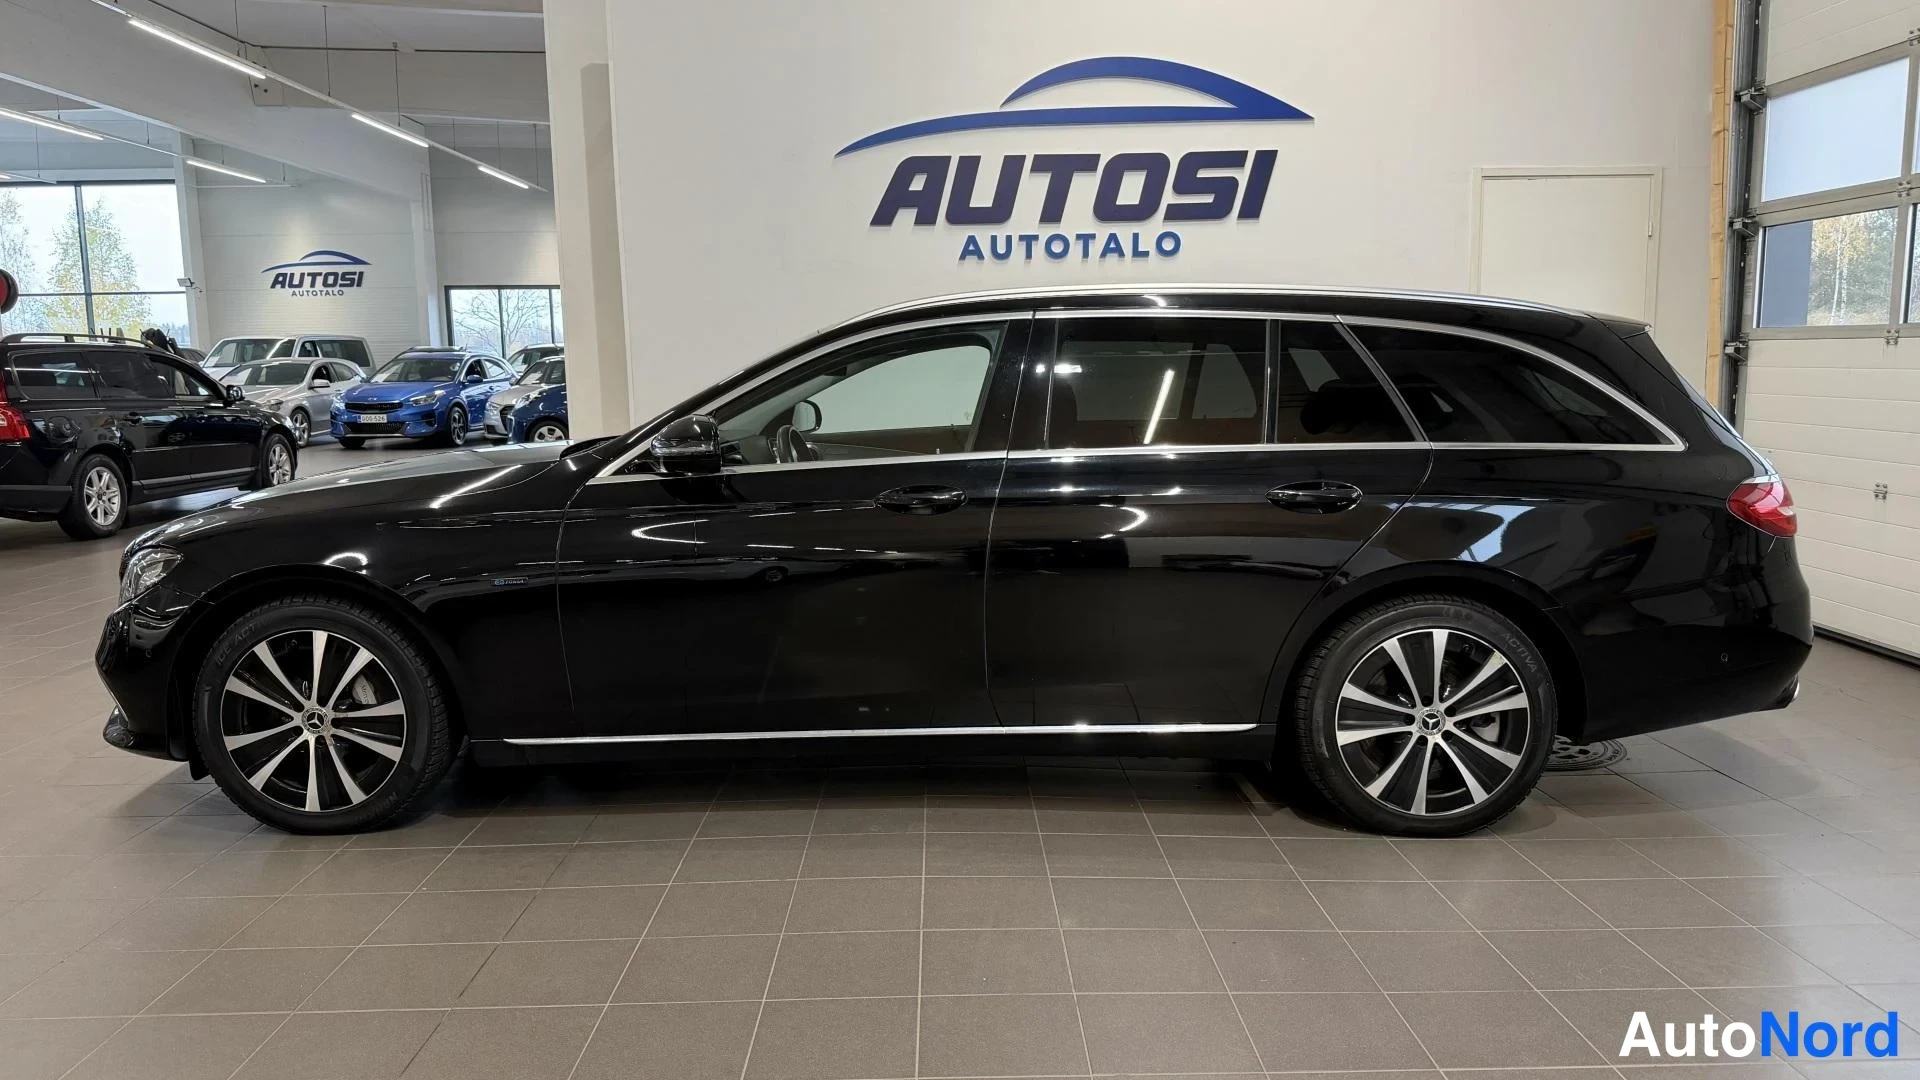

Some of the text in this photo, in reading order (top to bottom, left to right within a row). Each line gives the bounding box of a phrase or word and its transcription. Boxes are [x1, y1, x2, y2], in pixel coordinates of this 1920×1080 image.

[870, 149, 1279, 226] AUTOSI
[958, 230, 1182, 261] AUTOTALO
[270, 271, 364, 289] AUTOSI
[291, 289, 344, 297] AUTOTALO
